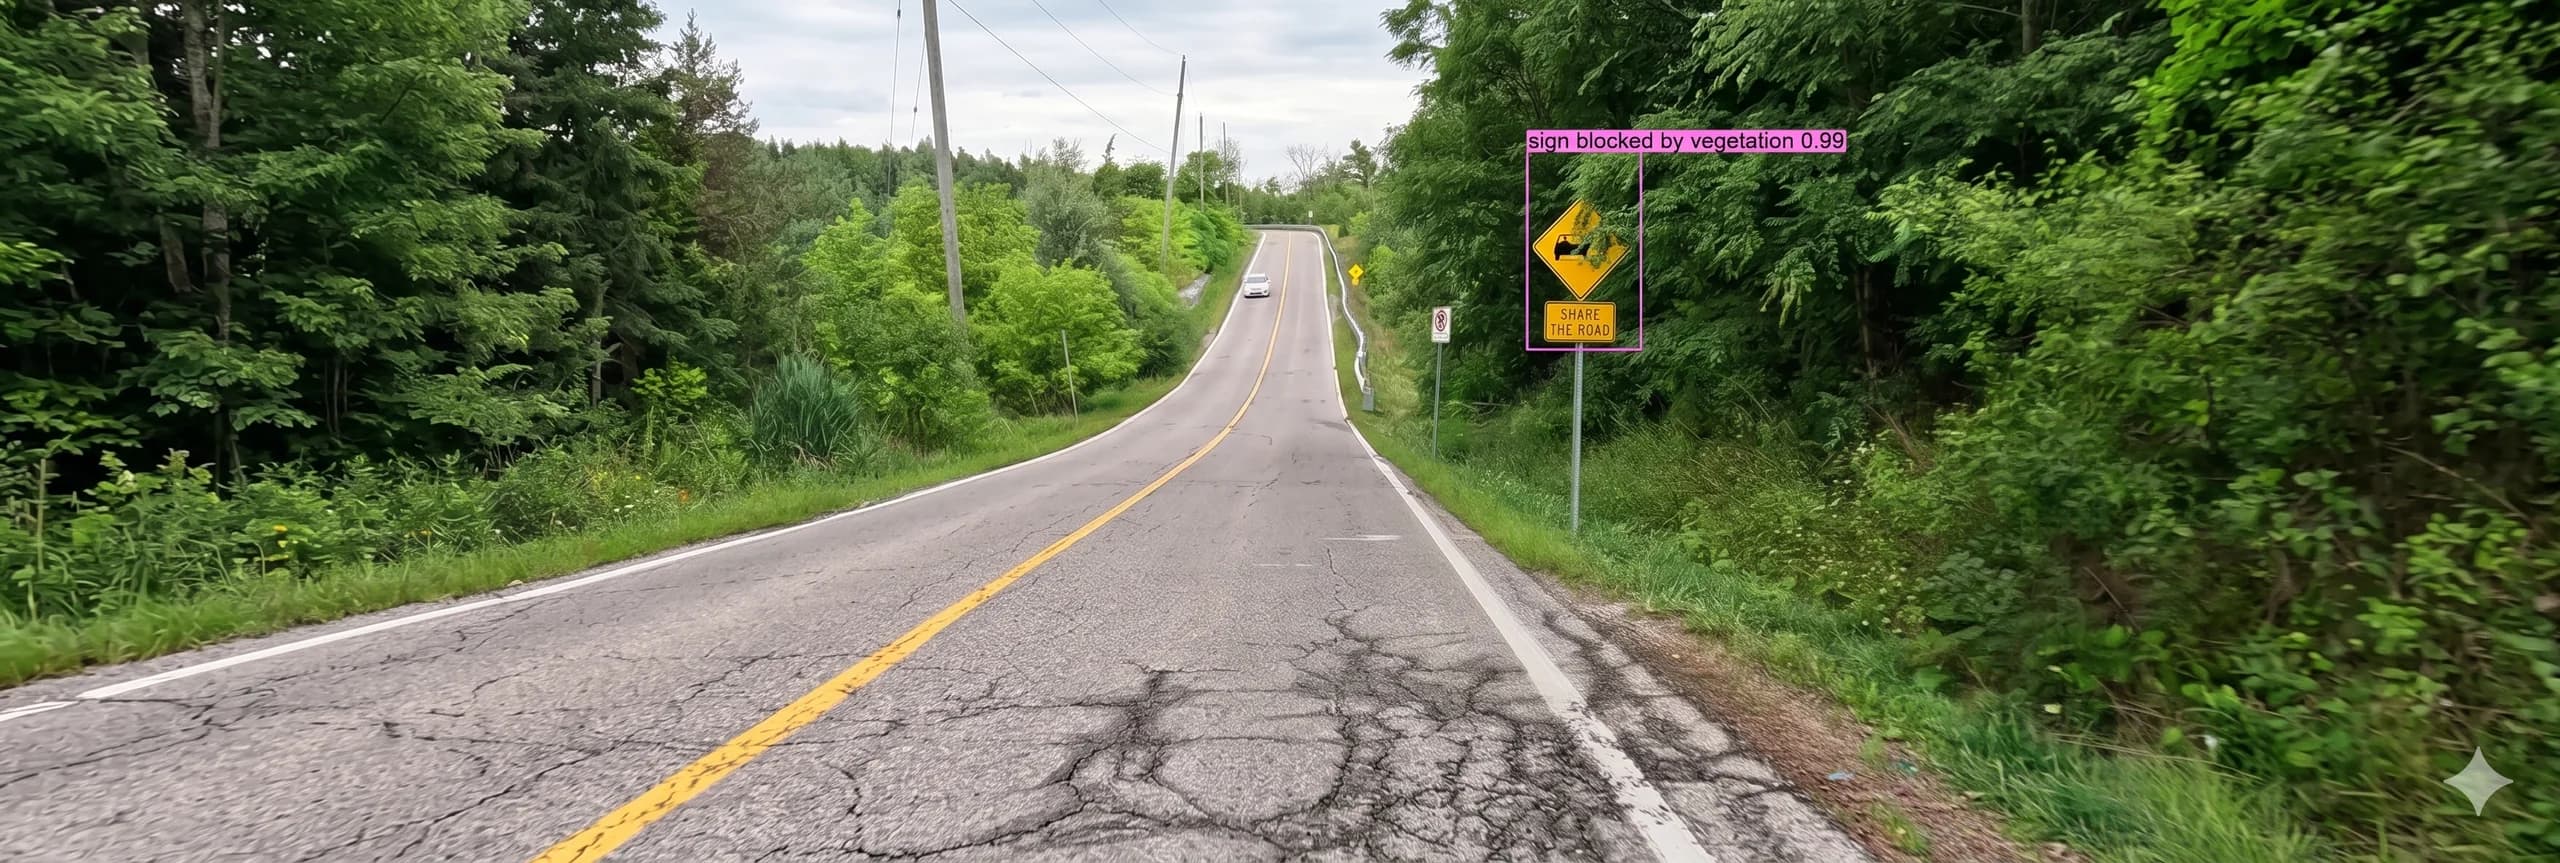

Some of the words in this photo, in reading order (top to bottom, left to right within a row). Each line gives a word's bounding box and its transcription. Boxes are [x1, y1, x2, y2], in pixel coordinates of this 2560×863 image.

[1561, 308, 1600, 321] SHARE
[1551, 324, 1573, 336] THE
[1578, 324, 1610, 336] ROAD
